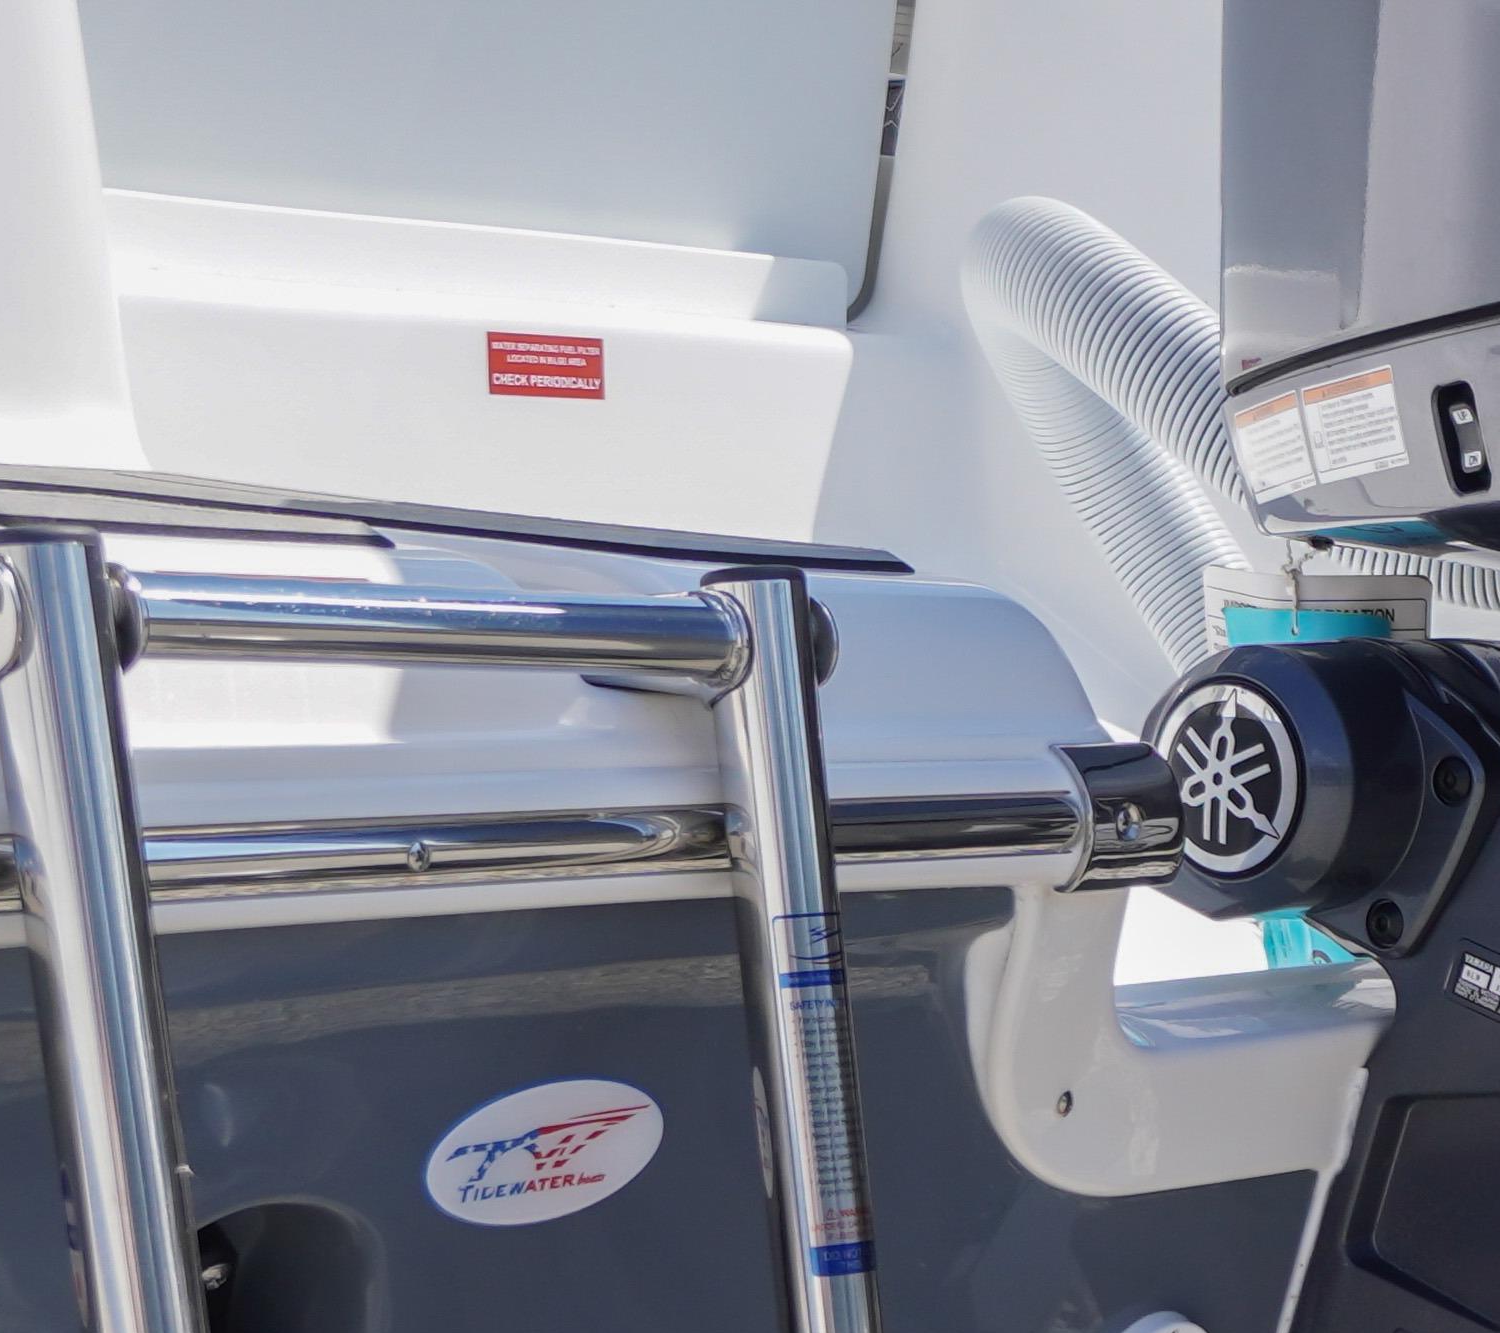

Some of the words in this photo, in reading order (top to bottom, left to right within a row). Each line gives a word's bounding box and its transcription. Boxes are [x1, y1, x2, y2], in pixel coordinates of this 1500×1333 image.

[492, 372, 530, 387] CHECK
[530, 374, 601, 390] PERIODICALLY
[458, 1174, 576, 1203] TIDEWATER
